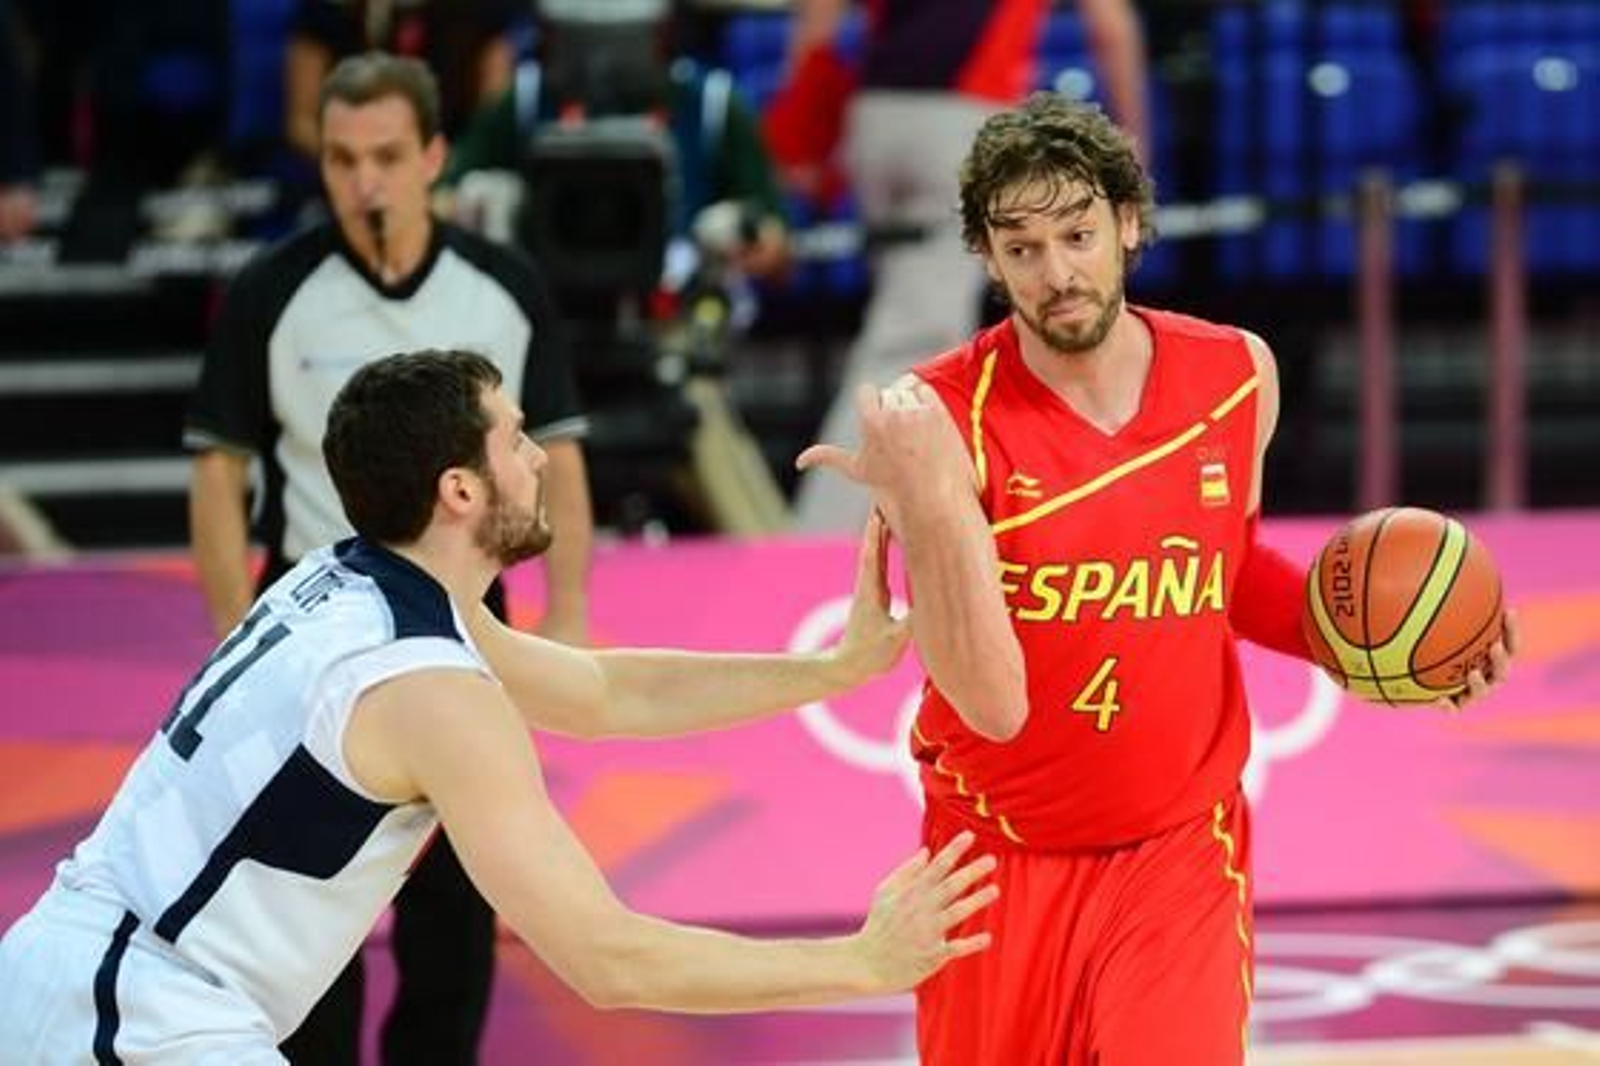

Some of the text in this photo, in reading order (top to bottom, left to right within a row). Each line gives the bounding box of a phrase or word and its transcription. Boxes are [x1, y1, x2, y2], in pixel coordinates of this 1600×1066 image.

[999, 535, 1224, 621] ESPAÑA
[1332, 559, 1355, 618] 2012
[1071, 657, 1121, 732] 4
